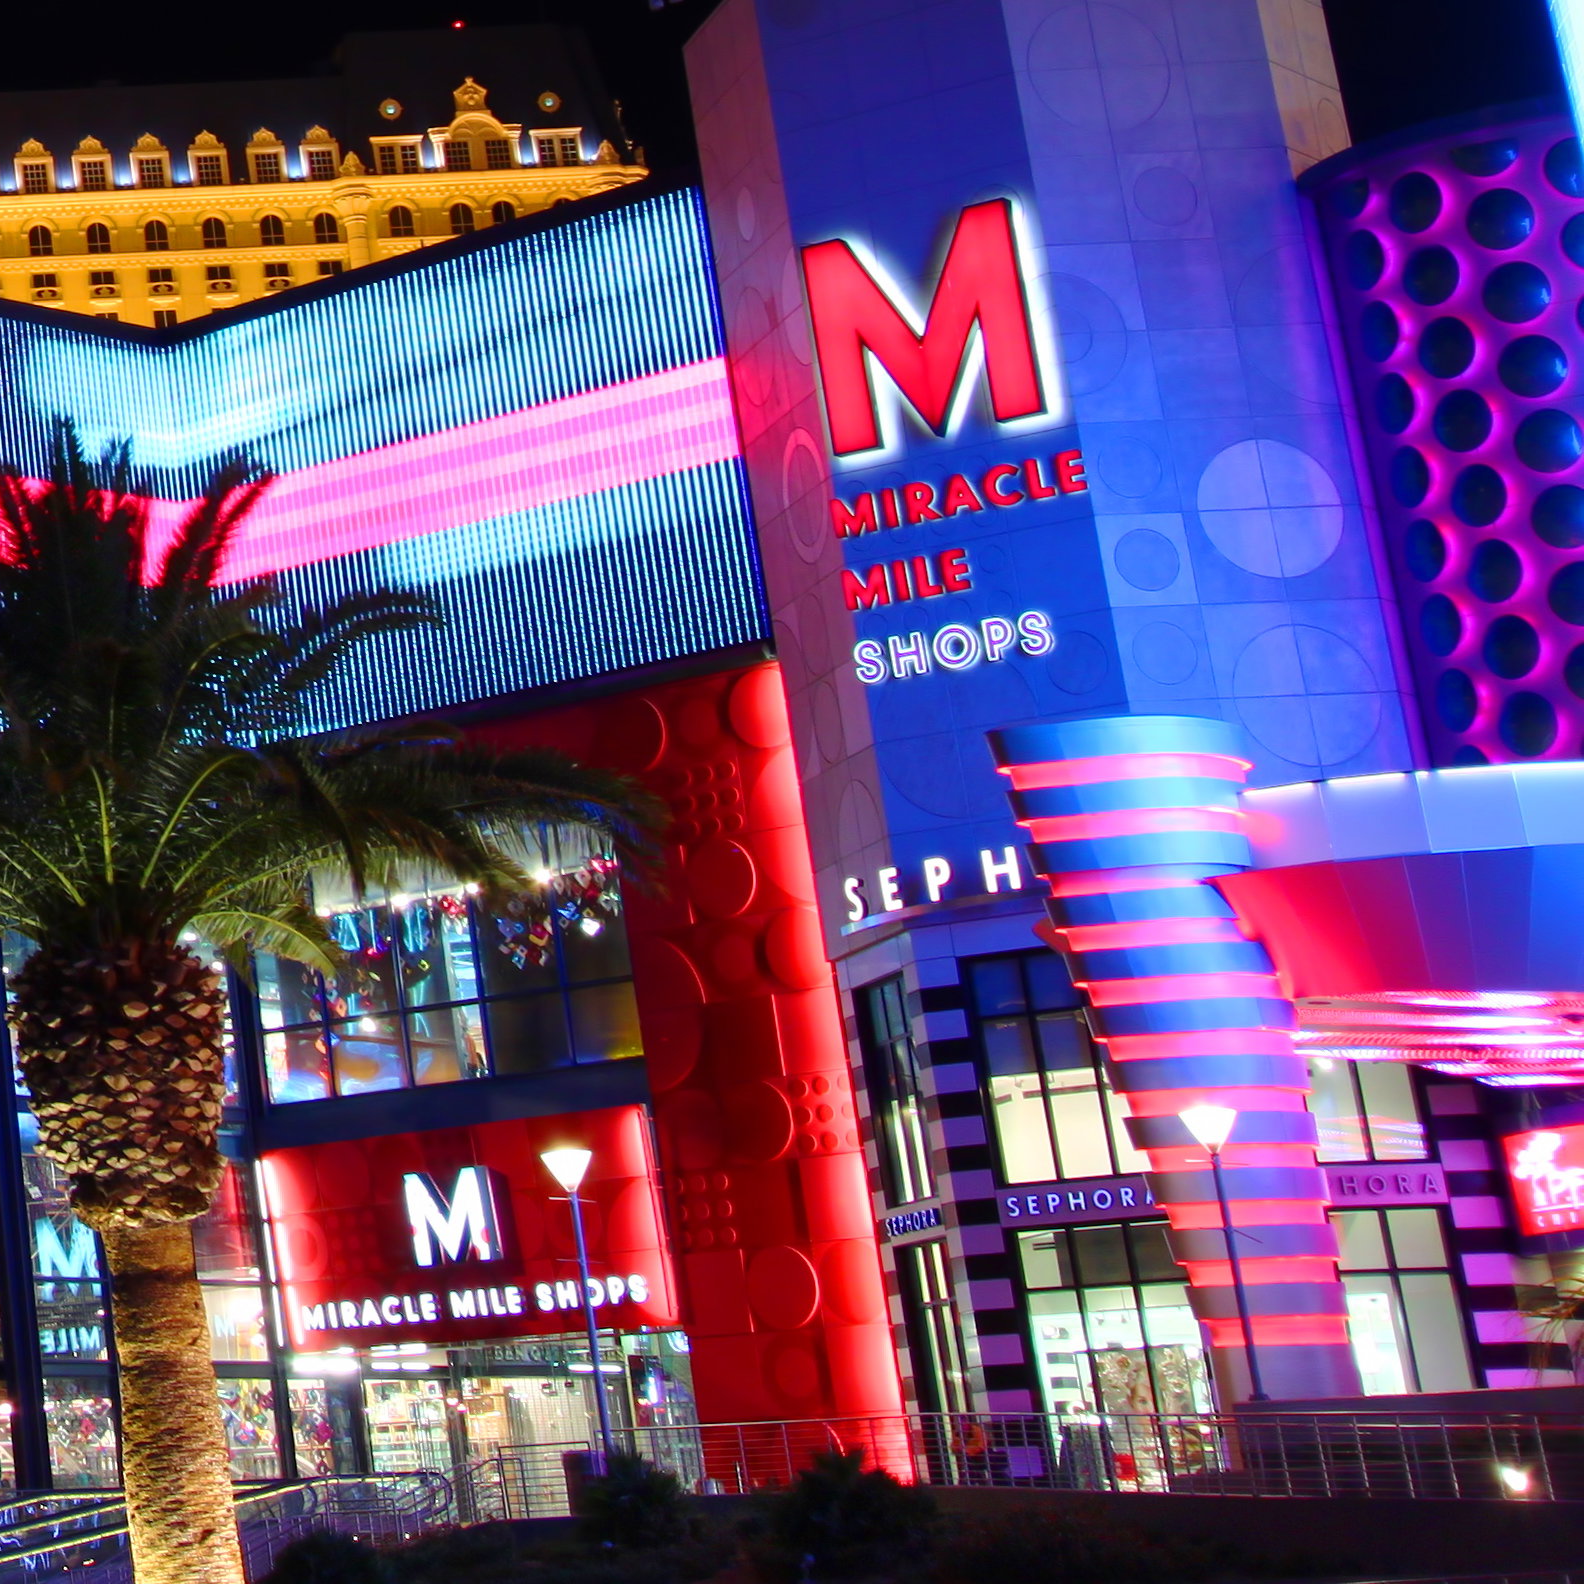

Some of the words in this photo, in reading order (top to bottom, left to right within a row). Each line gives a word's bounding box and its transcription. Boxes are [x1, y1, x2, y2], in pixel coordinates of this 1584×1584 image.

[800, 196, 1054, 460] M
[831, 449, 1089, 539] MIRACLE
[841, 547, 973, 612] MILE
[853, 610, 1054, 686] SHOPS
[844, 845, 1022, 922] SEPH
[402, 1165, 496, 1267] M
[885, 1208, 938, 1237] SEPHORA
[302, 1292, 438, 1330] MIRACLE
[449, 1285, 524, 1319] MILE
